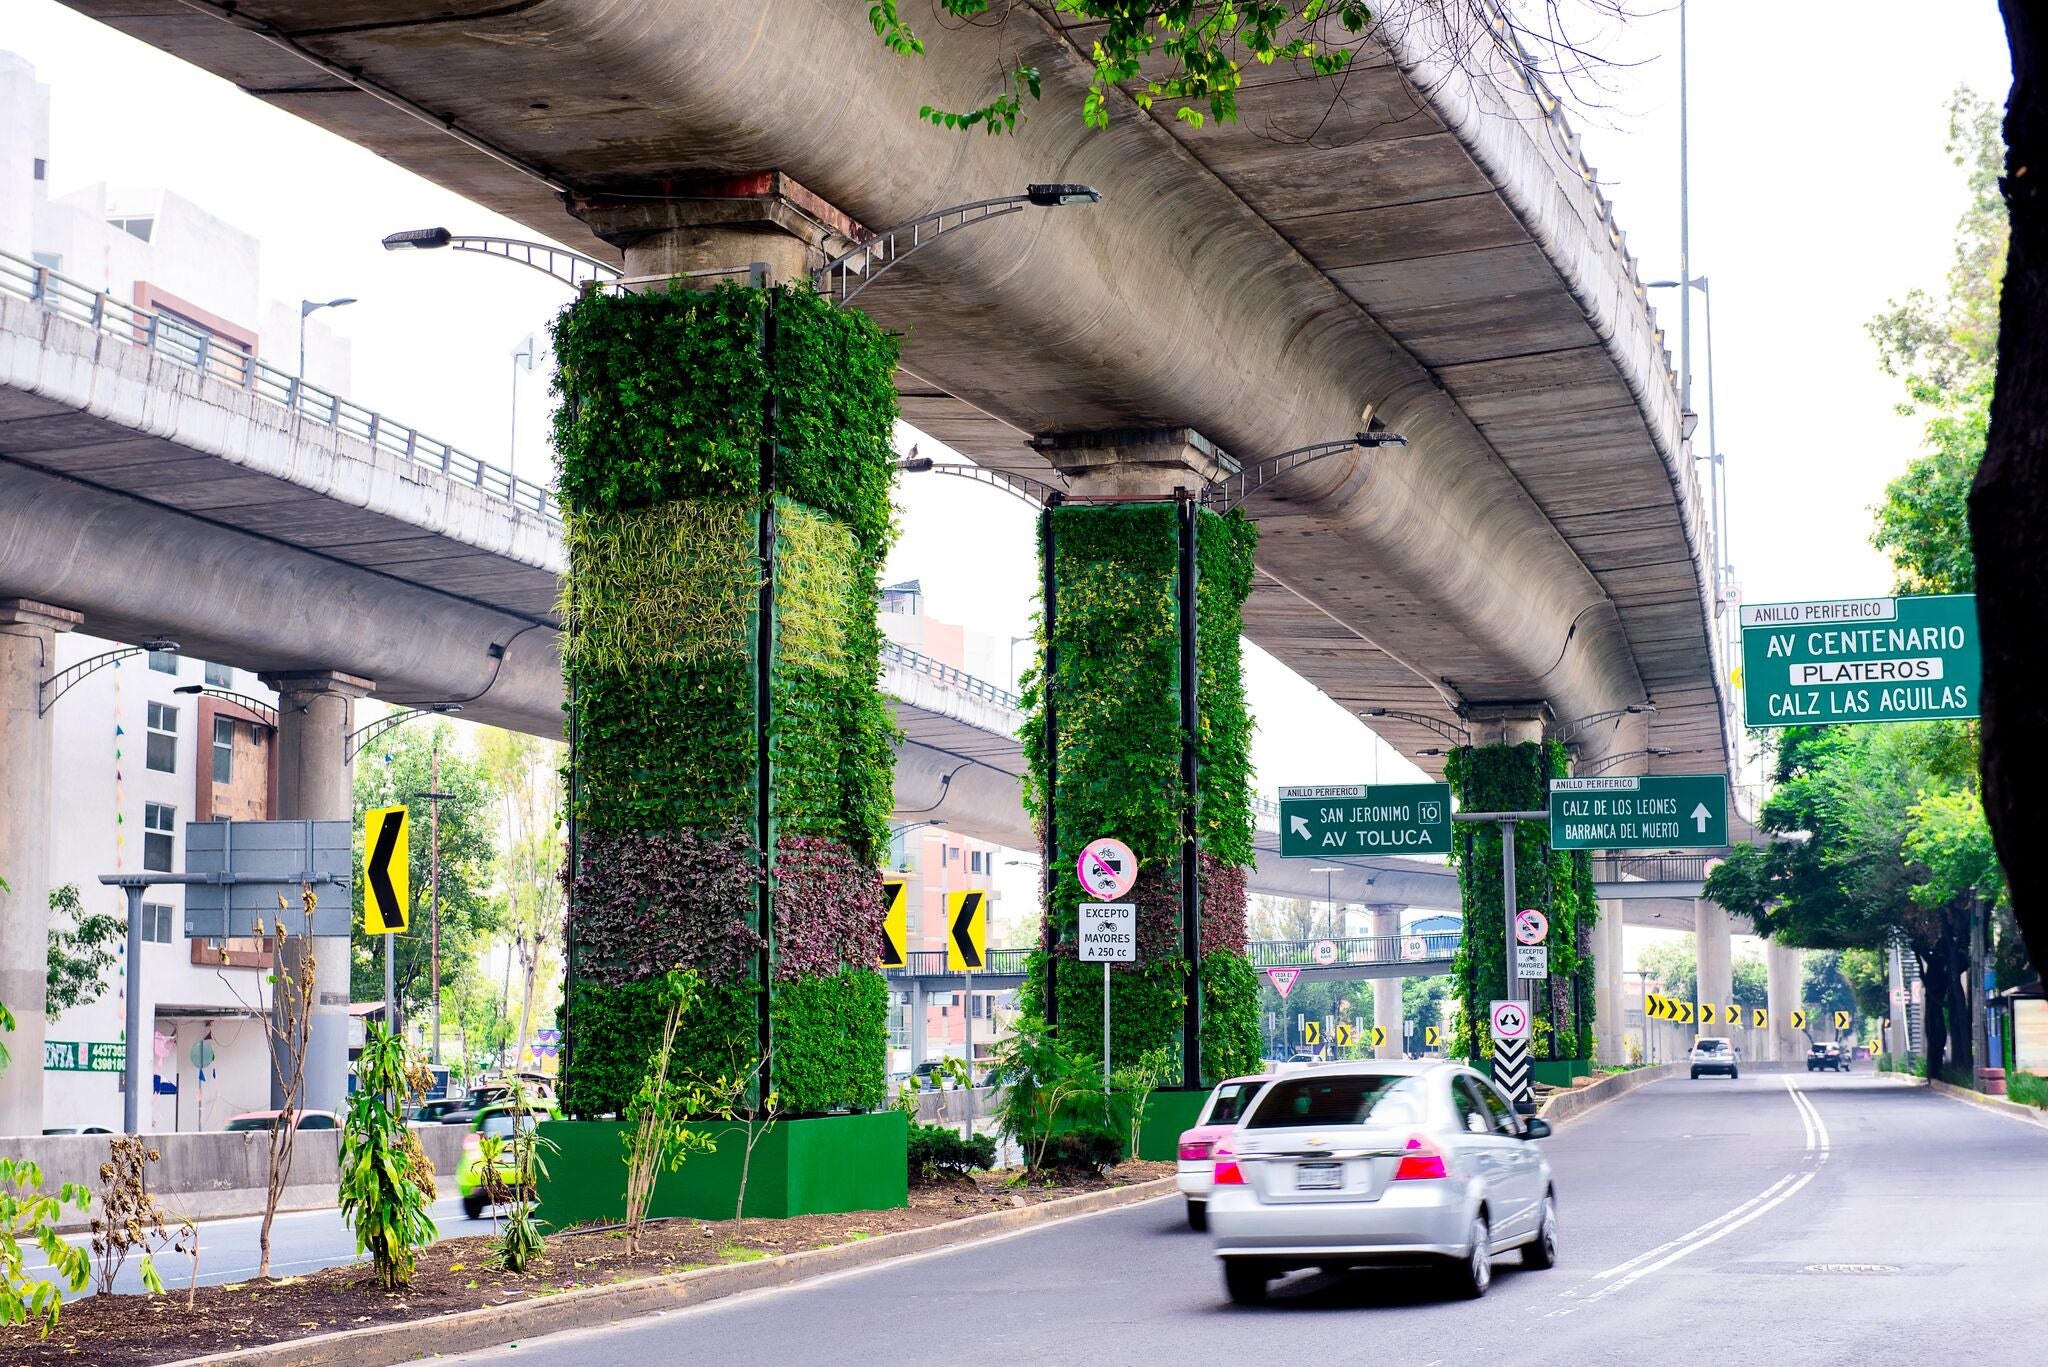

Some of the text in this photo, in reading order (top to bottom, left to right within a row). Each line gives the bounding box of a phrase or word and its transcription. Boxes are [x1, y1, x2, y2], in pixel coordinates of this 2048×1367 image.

[1755, 602, 1881, 622] ANILLO PERIFERICO
[1766, 625, 1965, 658] AV CENTENARIO
[1803, 660, 1930, 683] PLATEROS
[1769, 685, 1967, 717] CALZ LAS AGUILAS
[1287, 787, 1359, 797] ANILLO PERIFERICO
[1555, 779, 1633, 789] ANILLO PERIFERICO
[1320, 805, 1410, 823] SAN JERONIMO
[1421, 806, 1437, 819] 10
[1563, 798, 1677, 816] CALZ DE LOS LEONES
[1321, 829, 1432, 847] AV TOLUCA
[1565, 822, 1679, 840] BARRANCA DEL MUERTO
[1085, 908, 1129, 918] EXCEPTO
[1084, 933, 1130, 943] MAYORES
[1088, 948, 1094, 956] A
[1098, 947, 1114, 957] 250
[1320, 946, 1331, 954] 80
